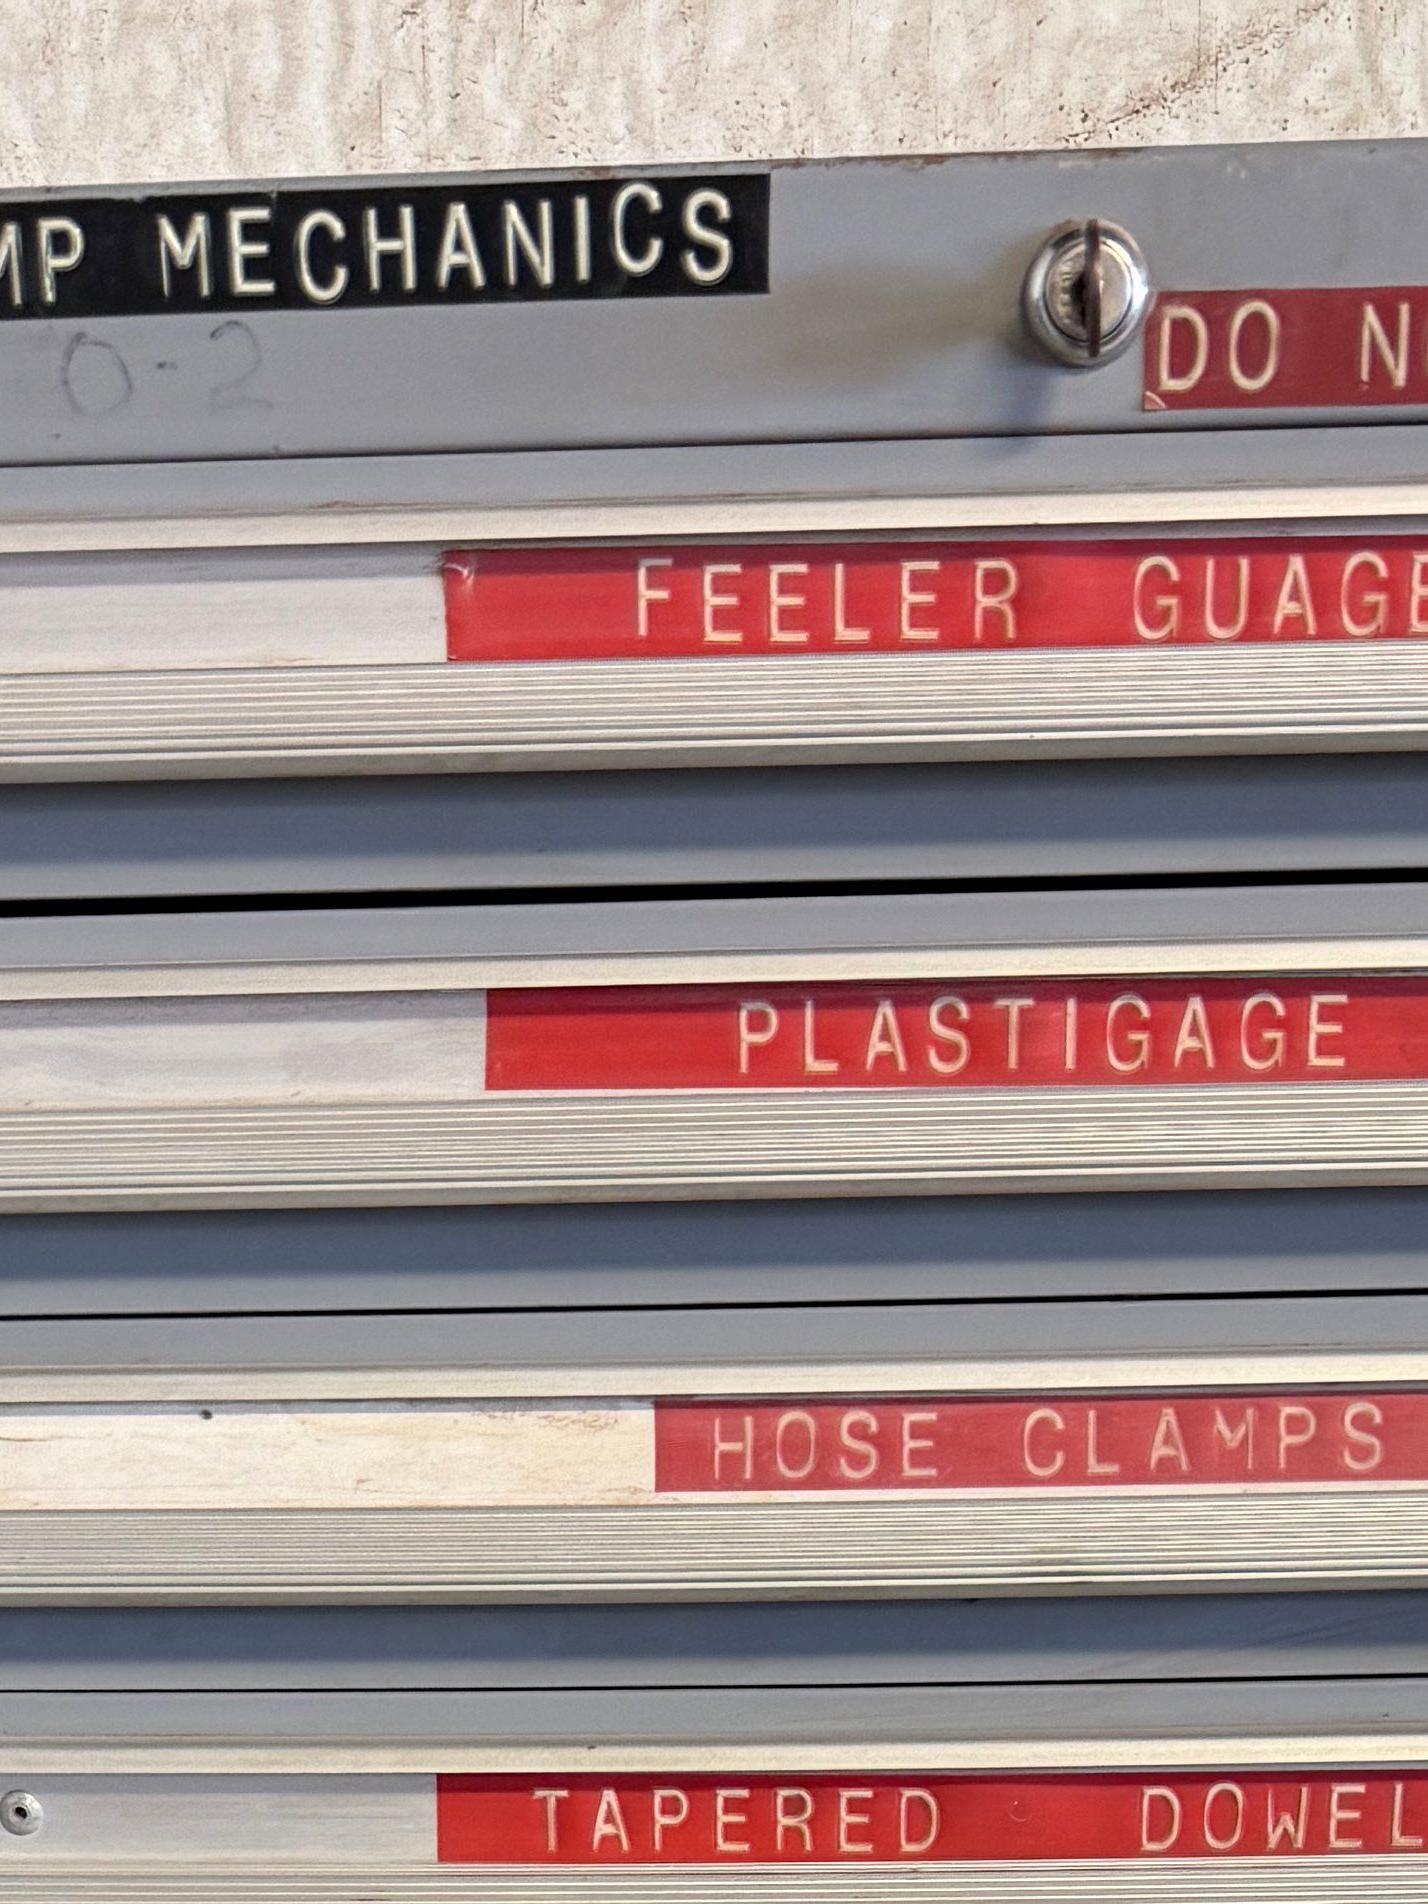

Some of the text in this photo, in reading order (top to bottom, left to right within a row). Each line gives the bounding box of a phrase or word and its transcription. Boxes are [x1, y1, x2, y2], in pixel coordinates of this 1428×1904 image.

[157, 183, 734, 305] MECHANICS
[1158, 297, 1281, 393] DO
[635, 557, 1020, 645] FEELER
[737, 992, 1350, 1074] PLASTIGAGE
[712, 1401, 1385, 1482] HOSE CLAMPS
[533, 1787, 942, 1854] TAPERED
